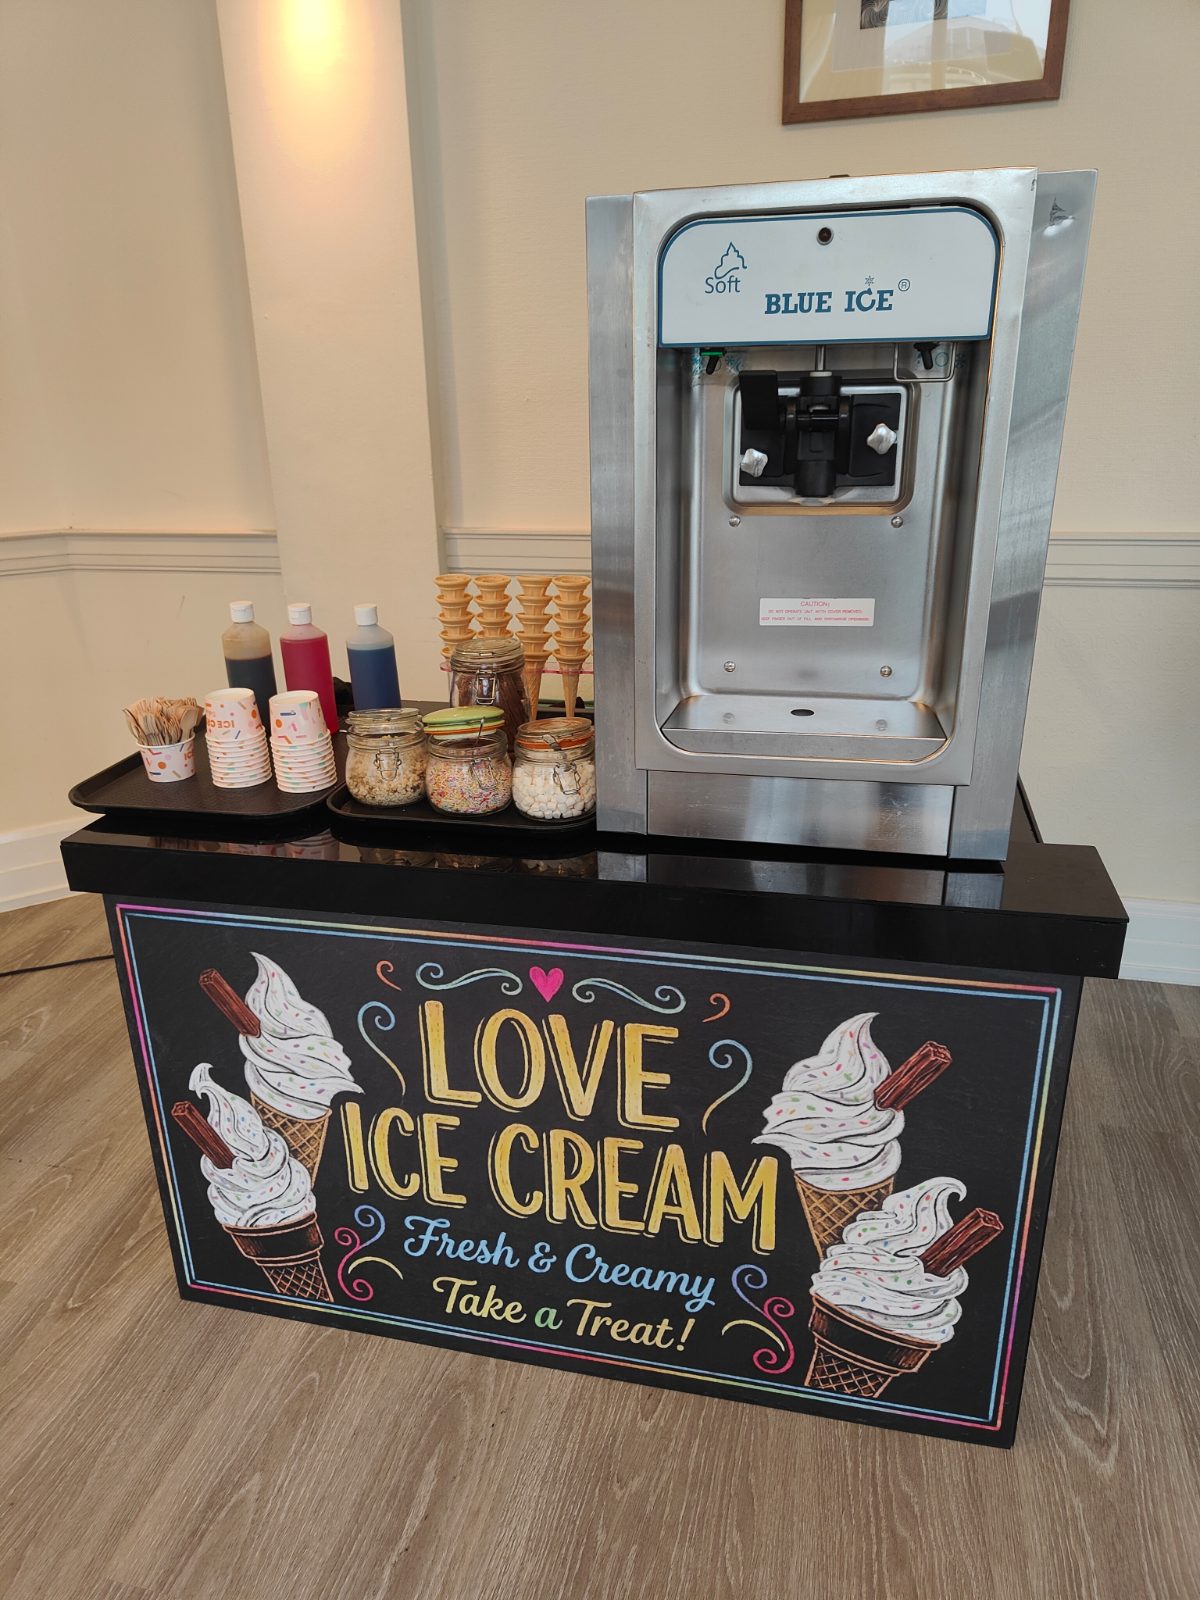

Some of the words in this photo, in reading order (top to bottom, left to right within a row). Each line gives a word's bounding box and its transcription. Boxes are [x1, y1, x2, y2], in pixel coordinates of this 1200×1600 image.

[704, 275, 741, 294] Soft
[764, 291, 833, 315] BLUE
[844, 287, 894, 312] ICE
[217, 720, 235, 729] ICE
[418, 1000, 680, 1132] LOVE
[340, 1102, 467, 1208] ICE
[487, 1123, 779, 1255] CREAM
[403, 1215, 520, 1269] Fresh
[527, 1242, 557, 1273] &
[565, 1243, 716, 1313] Creamy
[432, 1276, 527, 1324] Take
[534, 1307, 563, 1330] a
[566, 1299, 696, 1351] Treat!
